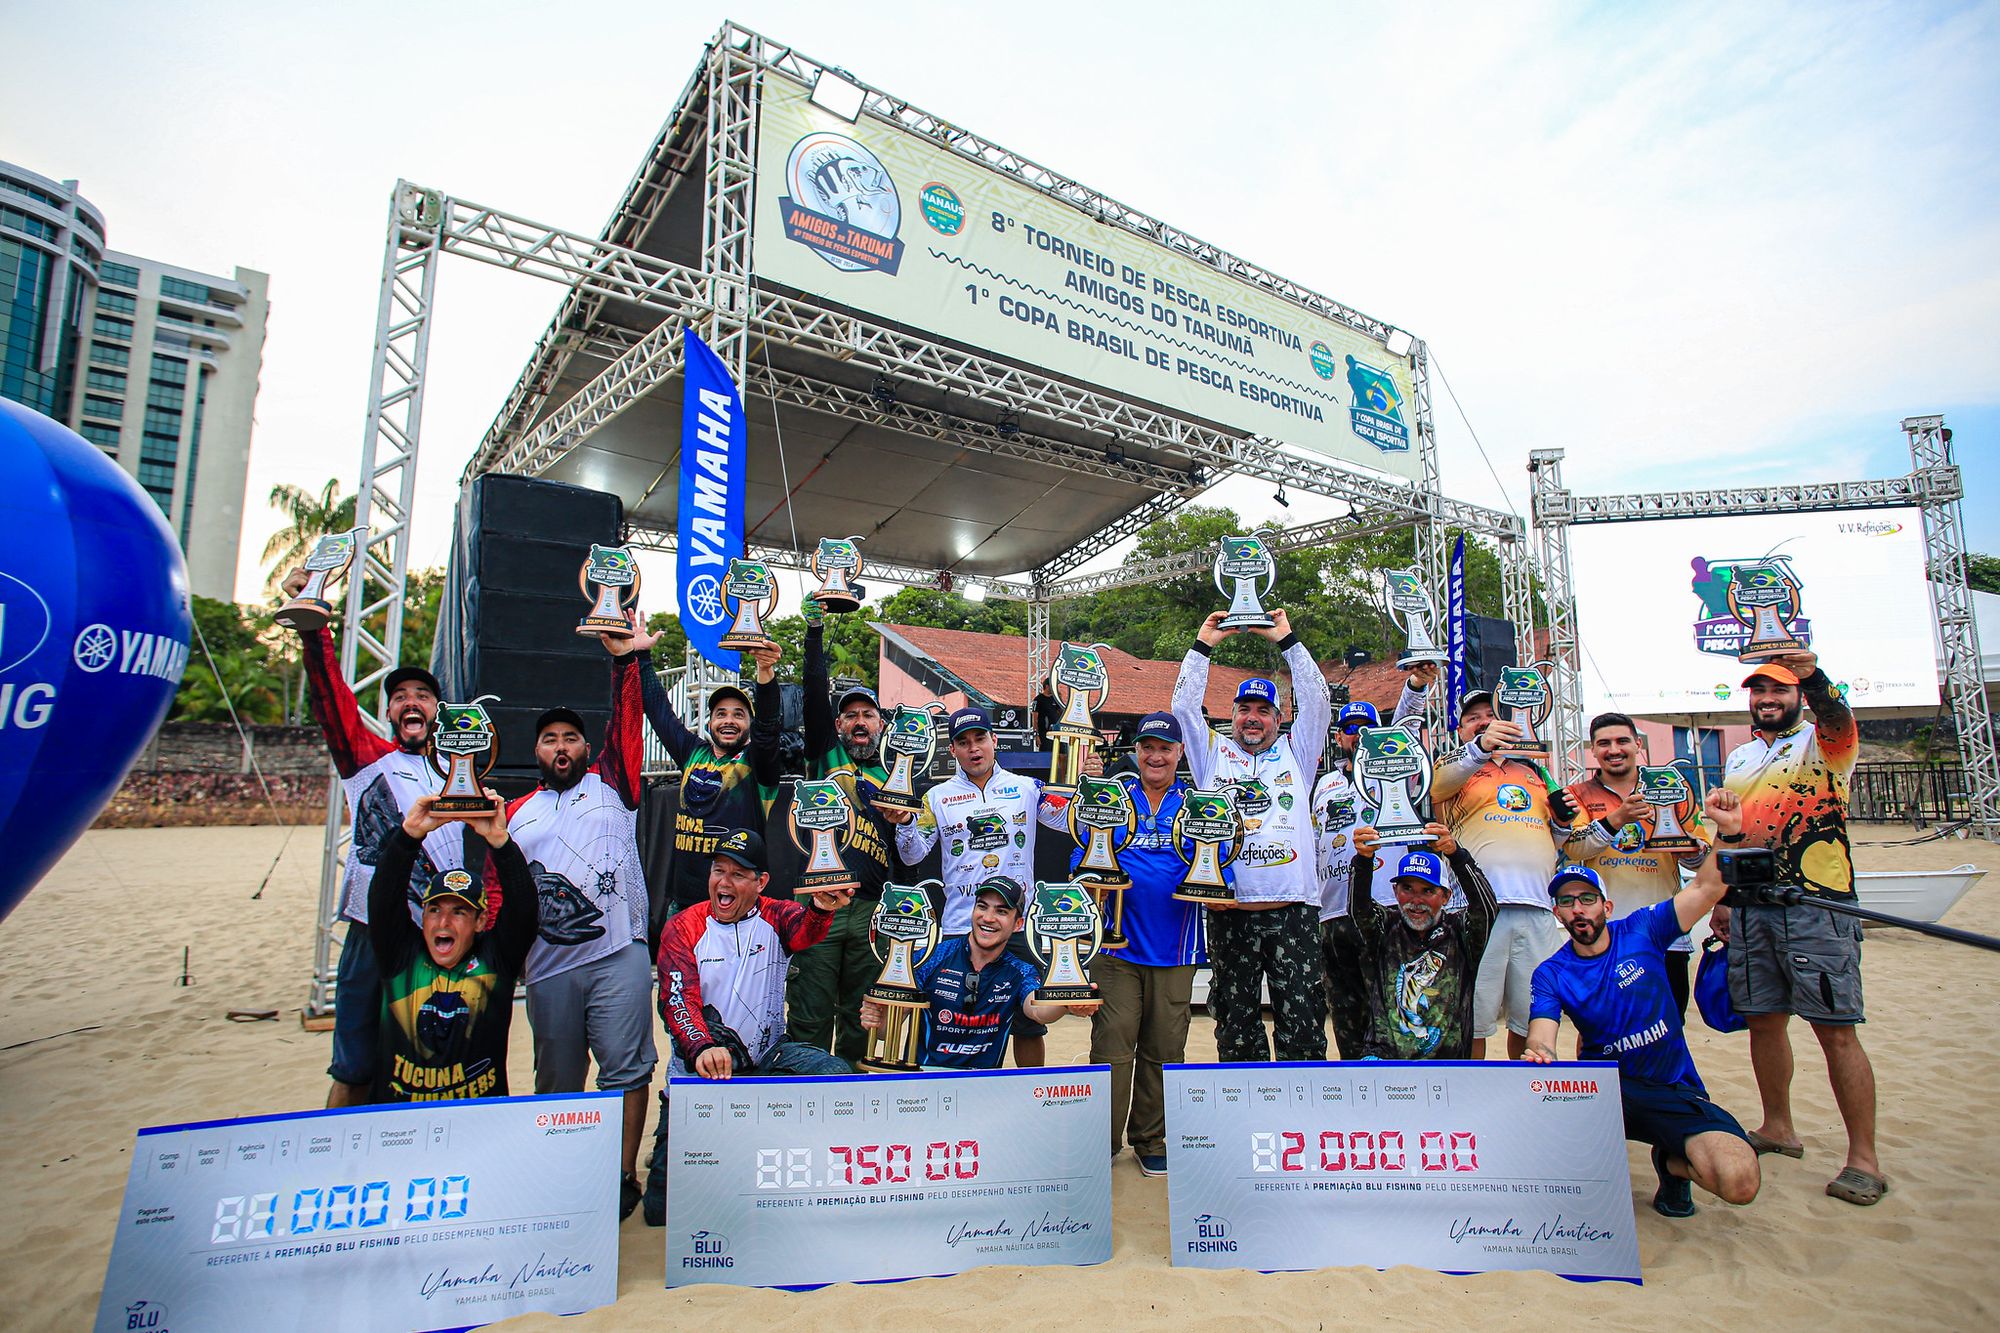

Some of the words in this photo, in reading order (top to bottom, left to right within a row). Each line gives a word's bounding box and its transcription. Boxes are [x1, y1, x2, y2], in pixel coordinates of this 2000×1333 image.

[921, 190, 965, 216] MANAUS
[789, 209, 839, 240] AMIGOS
[847, 229, 895, 261] TARUMÃ
[824, 239, 833, 250] DE
[832, 241, 851, 256] PESCA
[850, 247, 880, 266] ESPORTIVA
[1023, 224, 1115, 278] TORNEIO
[1121, 265, 1147, 291] DE
[1152, 277, 1212, 317] PESCA
[1216, 304, 1304, 353] ESPORTIVA
[1064, 270, 1145, 315] AMIGOS
[1151, 302, 1178, 328] DO
[1183, 314, 1255, 358] TARUMÃ
[999, 295, 1060, 334] COPA
[1067, 318, 1140, 361] BRASIL
[1145, 346, 1171, 372] DE
[1177, 358, 1235, 394] PESCA
[1239, 379, 1324, 424] ESPORTIVA
[1309, 349, 1335, 365] MANAUS
[1360, 412, 1376, 426] COPA
[1376, 418, 1394, 432] BRASIL
[1394, 425, 1402, 435] DE
[1355, 423, 1375, 439] PESCA
[1376, 431, 1407, 449] ESPORTIVA
[690, 387, 732, 567] YAMAHA
[1856, 520, 1892, 536] Refeições
[610, 620, 627, 628] LUGAR
[1452, 555, 1465, 684] YAMAHA
[1713, 623, 1739, 635] COPA
[1703, 639, 1739, 651] PESCA
[1750, 643, 1772, 651] EQUIPE
[1250, 681, 1263, 690] BLU
[1244, 689, 1269, 697] FISHING
[948, 793, 977, 802] YAMAHA
[1484, 812, 1544, 825] Gegekeiros
[1379, 829, 1395, 837] QUIPE
[1524, 822, 1545, 831] Team
[1410, 857, 1426, 866] BLU
[1599, 855, 1658, 867] Gegekeiros
[1403, 866, 1432, 875] FISHING
[1636, 865, 1659, 873] Team
[1618, 963, 1636, 978] BLU
[1617, 966, 1645, 990] FISHING
[936, 1025, 966, 1034] SPORT
[1613, 1018, 1668, 1053] YAMAHA
[936, 1042, 992, 1055] QUEST
[393, 1054, 466, 1089] TUCUNA
[1046, 1084, 1092, 1098] YAMAHA
[1187, 1088, 1207, 1096] Comp.
[1257, 1086, 1282, 1094] Agência
[1384, 1085, 1406, 1094] Cheque
[1545, 1080, 1598, 1093] YAMAHA
[551, 1111, 601, 1126] YAMAHA
[1195, 1142, 1216, 1150] cheque
[1254, 1183, 1300, 1191] REFERENTE
[1313, 1181, 1362, 1193] PREMIAÇÃO
[1366, 1182, 1382, 1191] BLU
[1386, 1182, 1422, 1191] FISHING
[1425, 1183, 1447, 1191] PELO
[1450, 1184, 1508, 1192] DESEMPENHO
[1512, 1184, 1540, 1193] NESTE
[1544, 1185, 1582, 1195] TORNEIO
[756, 1199, 804, 1208] REFERENTE
[817, 1196, 866, 1207] PREMIAÇÃO
[870, 1195, 886, 1204] BLU
[890, 1192, 924, 1203] FISHING
[927, 1191, 948, 1200] PELO
[951, 1187, 1004, 1199] DESEMPENHO
[1007, 1185, 1033, 1195] NESTE
[1036, 1183, 1069, 1193] TORNEIO
[946, 1219, 1014, 1248] Yamaha
[1021, 1211, 1093, 1241] Náutica
[1199, 1224, 1225, 1238] BLU
[1449, 1217, 1524, 1243] Yamaha
[1532, 1214, 1614, 1244] Náutica
[207, 1251, 260, 1267] REFERENTE
[275, 1243, 332, 1259] PREMIAÇÃO
[336, 1241, 355, 1252] BLU
[359, 1236, 400, 1249] FISHING
[404, 1234, 429, 1244] PELO
[432, 1225, 494, 1242] DESEMPENHO
[499, 1223, 528, 1235] NESTE
[532, 1219, 570, 1231] TORNEIO
[695, 1240, 722, 1253] BLU
[976, 1245, 1003, 1254] YAMAHA
[1005, 1243, 1034, 1251] NÁUTICA
[1036, 1241, 1060, 1250] BRASIL
[1188, 1240, 1238, 1253] FISHING
[1482, 1245, 1513, 1254] YAMAHA
[1515, 1244, 1548, 1254] NÁUTICA
[1551, 1246, 1579, 1256] BRASIL
[682, 1256, 734, 1268] FISHING
[421, 1264, 502, 1300] Yamaha
[509, 1252, 595, 1289] Náutica
[127, 1310, 159, 1330] BLU
